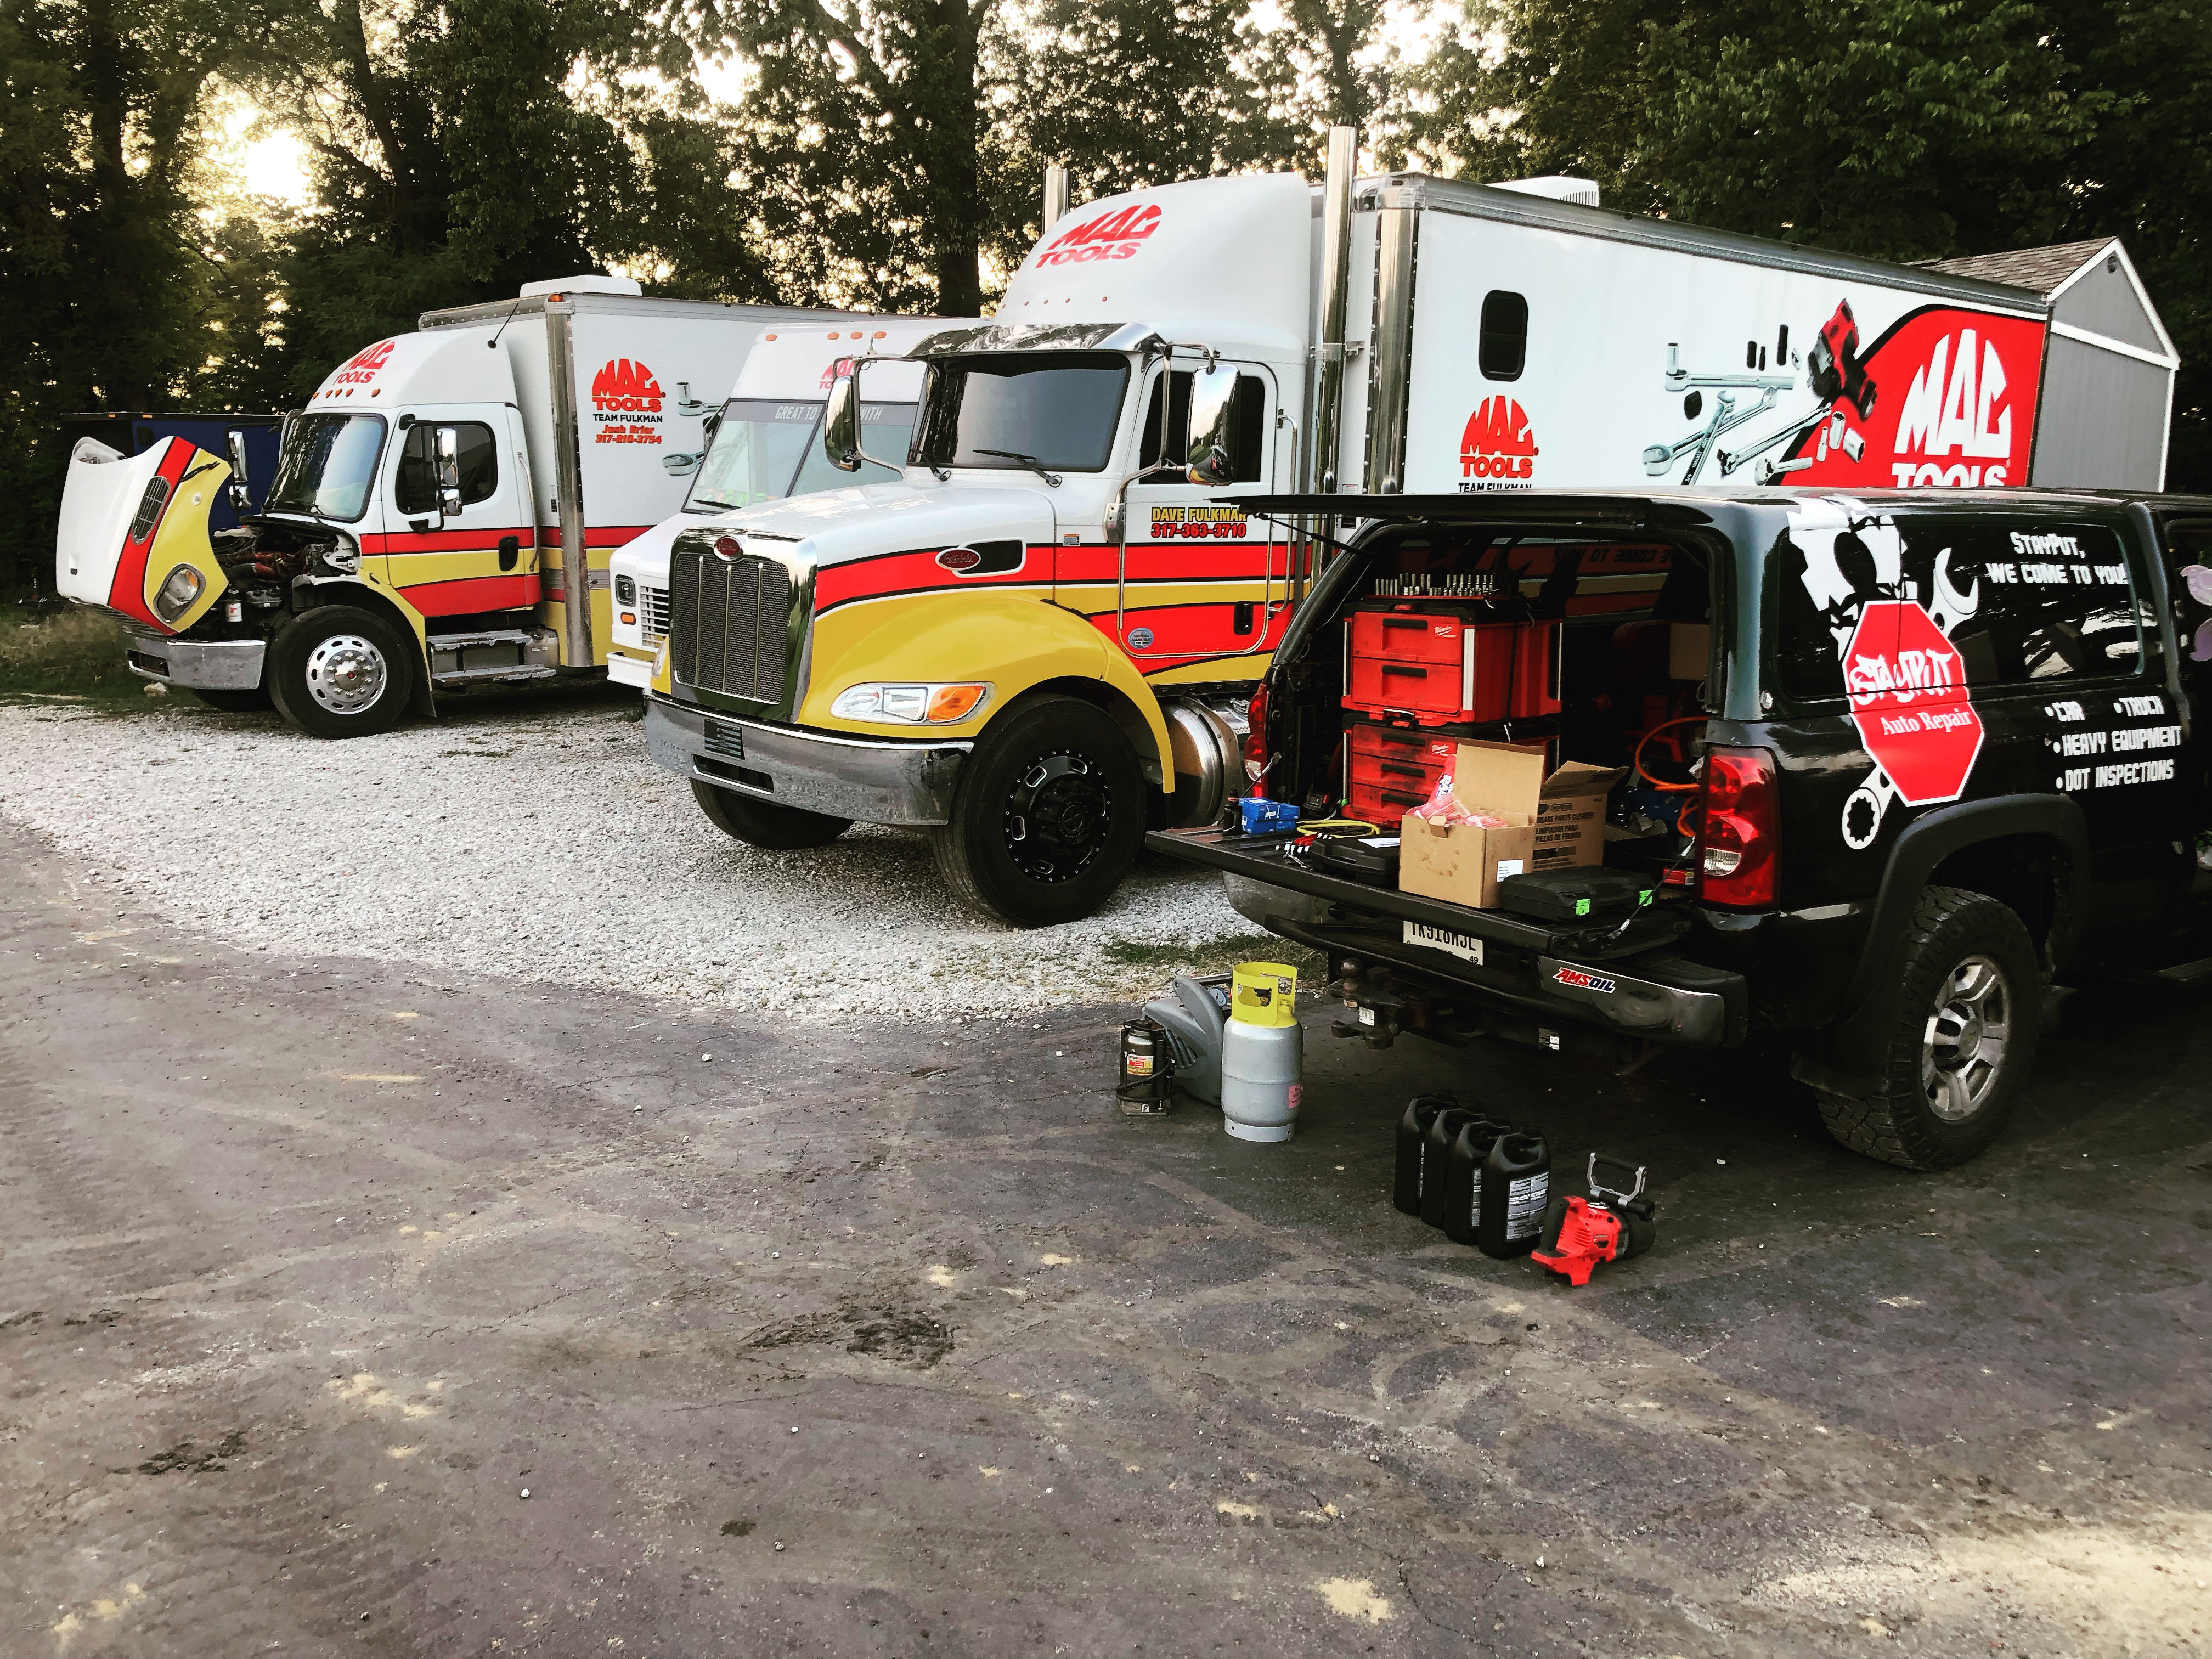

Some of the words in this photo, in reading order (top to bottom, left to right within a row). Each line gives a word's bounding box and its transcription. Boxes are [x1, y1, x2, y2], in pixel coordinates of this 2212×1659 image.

[1045, 204, 1162, 251] MAC
[1034, 242, 1141, 269] TOOLS
[332, 371, 375, 386] TOOLS
[592, 358, 662, 398] MAC
[1893, 328, 2011, 458] MAC
[592, 397, 662, 412] TOOLS
[775, 406, 805, 421] GREAT
[804, 407, 818, 421] TO
[620, 414, 663, 422] FULKMAN
[1460, 395, 1534, 456] MAC
[602, 424, 626, 433] Josh
[1460, 456, 1532, 478] TOOLS
[1458, 482, 1485, 493] TEAM
[1152, 506, 1185, 522] DAVE
[1150, 522, 1247, 538] 317-363-3710
[1985, 563, 2018, 583] WE
[2021, 563, 2069, 584] COME
[2069, 565, 2093, 584] TO
[2094, 563, 2130, 585] YOU!
[2052, 701, 2086, 722] CAR
[2118, 695, 2166, 716] TRUCK
[1880, 716, 1921, 735] Auto
[1917, 707, 1972, 733] Repair
[2062, 731, 2107, 757] HEAVY
[2111, 725, 2182, 752] EQUIPMENT
[2064, 768, 2091, 792] DOT
[2095, 759, 2175, 788] INSPECTIONS
[1536, 815, 1554, 824] BRAKE
[1554, 814, 1571, 822] PARTS
[1572, 811, 1594, 820] CLEANER
[1564, 824, 1578, 832] PARA
[1536, 834, 1553, 843] PIEZAS
[1469, 956, 1479, 964] 49
[1554, 967, 1615, 992] AMSOIL
